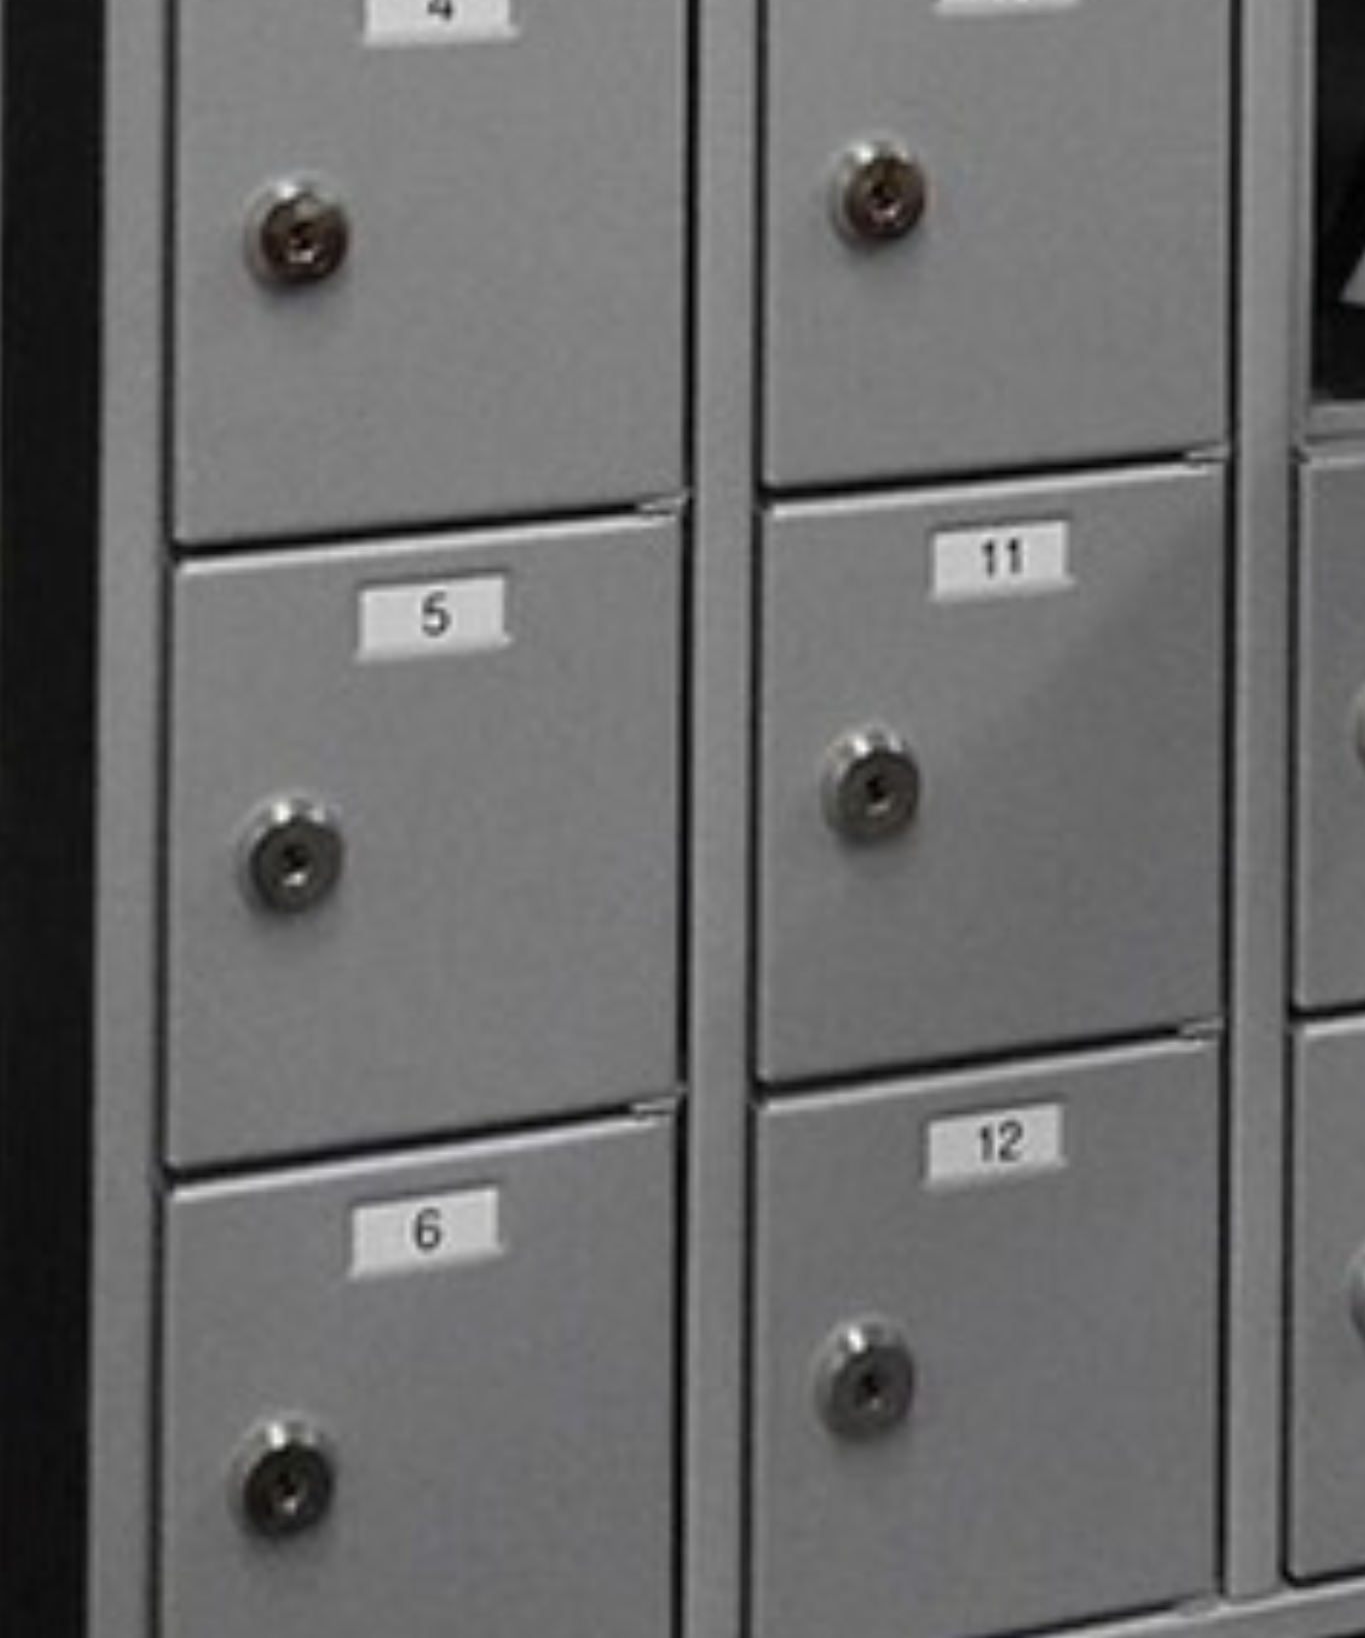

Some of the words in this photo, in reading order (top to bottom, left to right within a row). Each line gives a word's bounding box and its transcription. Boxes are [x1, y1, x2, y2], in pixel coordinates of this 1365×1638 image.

[982, 537, 1020, 578] 11
[422, 592, 451, 637] 5
[979, 1120, 1023, 1162] 12
[414, 1208, 442, 1252] 6
